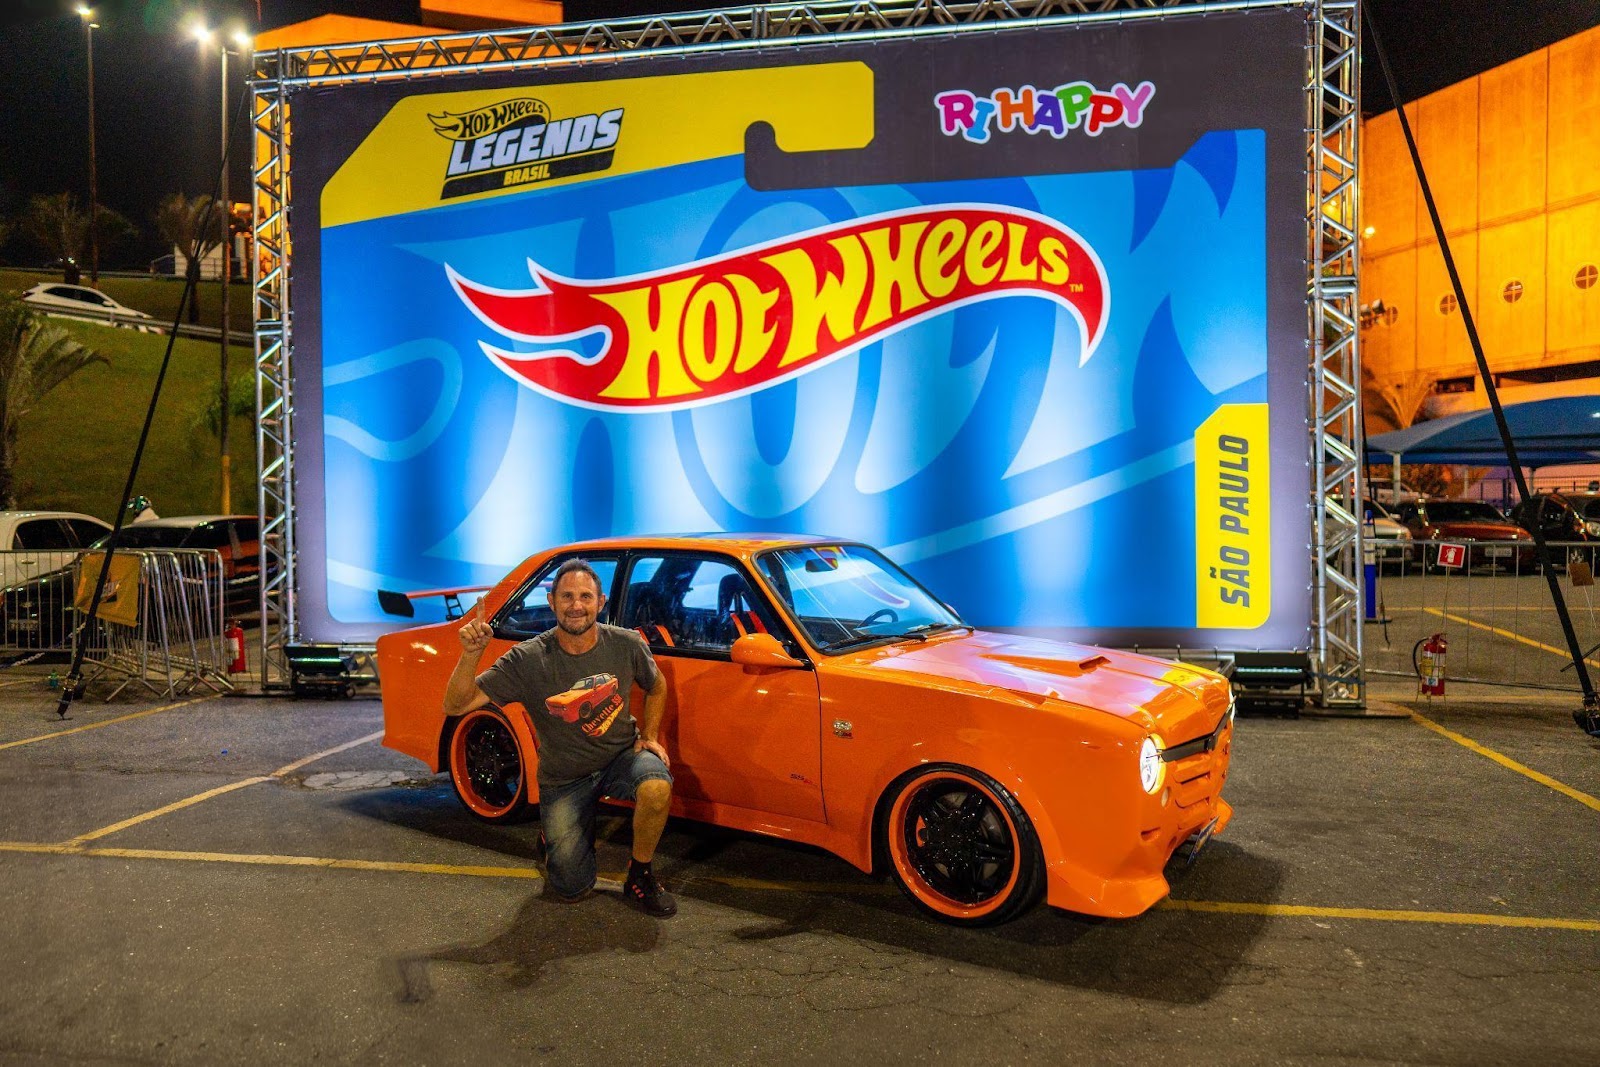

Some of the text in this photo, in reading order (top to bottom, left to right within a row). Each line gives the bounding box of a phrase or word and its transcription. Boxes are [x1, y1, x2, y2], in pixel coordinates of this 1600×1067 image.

[447, 108, 624, 176] LEGENDS
[458, 100, 544, 138] HOT WHEELS
[936, 83, 1153, 142] RI HAPPY
[503, 164, 550, 186] BRASIL
[589, 218, 1070, 399] HOT WHEELS
[1210, 434, 1250, 608] SÃO PAULO
[581, 704, 614, 733] Chevette
